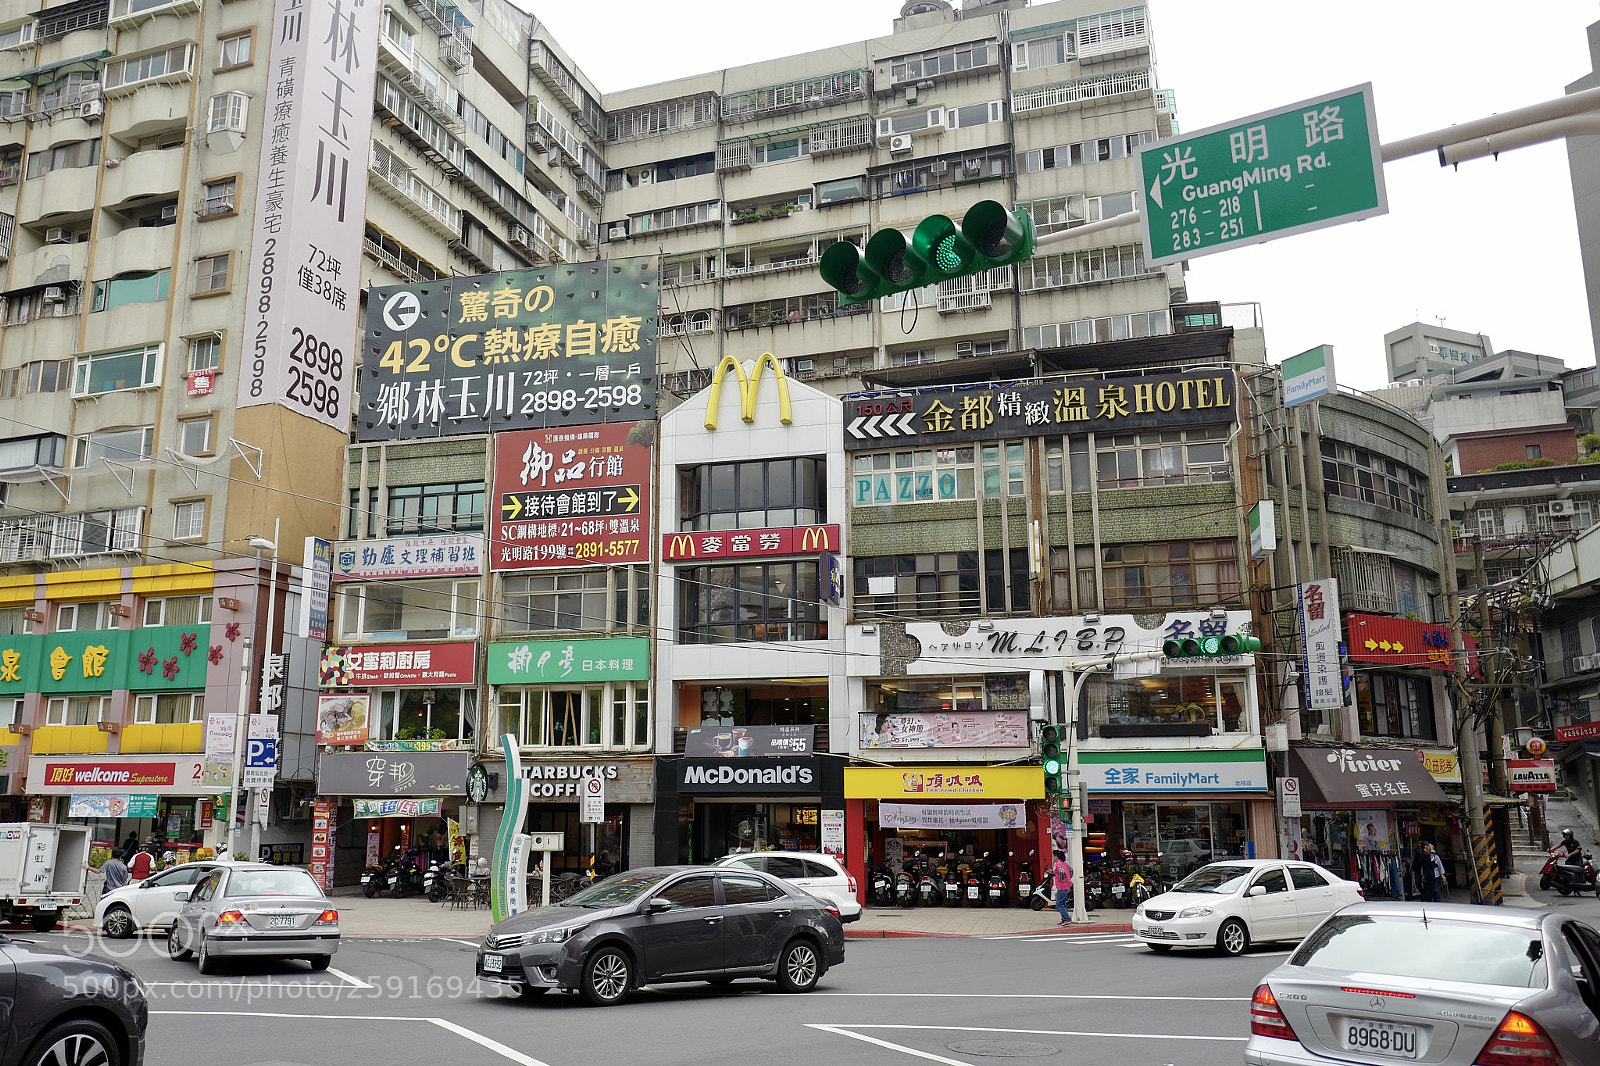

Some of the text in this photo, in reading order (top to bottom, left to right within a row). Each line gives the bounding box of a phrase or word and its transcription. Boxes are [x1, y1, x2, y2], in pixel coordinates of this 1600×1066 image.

[311, 0, 364, 222] 林玉川
[1161, 105, 1344, 186] 光明路
[1182, 152, 1331, 202] GuangMing Rd.
[1171, 207, 1197, 229] 276
[1219, 196, 1240, 217] 218
[1173, 229, 1201, 251] 283
[1220, 217, 1244, 240] 251
[308, 244, 342, 278] 72坪
[297, 264, 347, 312] 僅38席
[458, 285, 555, 324] 驚奇の
[290, 326, 344, 382] 2898
[286, 365, 340, 419] 2598
[376, 371, 515, 428] 鄉林玉川
[520, 384, 642, 415] 2898-2598
[1286, 374, 1326, 395] FamilyMart
[856, 400, 912, 416] 150 公尺
[520, 440, 624, 487] 御品行館
[857, 473, 955, 502] PAZZO
[524, 490, 617, 517] 接待會館到了
[575, 539, 640, 560] 2891-5577
[702, 532, 780, 553] 麥當勞
[1304, 584, 1325, 621] 名留
[582, 658, 634, 671] 日本料理
[247, 741, 264, 766] P
[49, 766, 168, 785] 頂好 wellcome Superstore
[521, 765, 618, 779] TARBUCKS
[684, 765, 813, 784] McDonald's
[926, 774, 983, 788] 頂呱呱
[1104, 767, 1140, 785] 全家
[1146, 772, 1219, 787] FamilyMart
[1513, 771, 1550, 780] LAVAZZA
